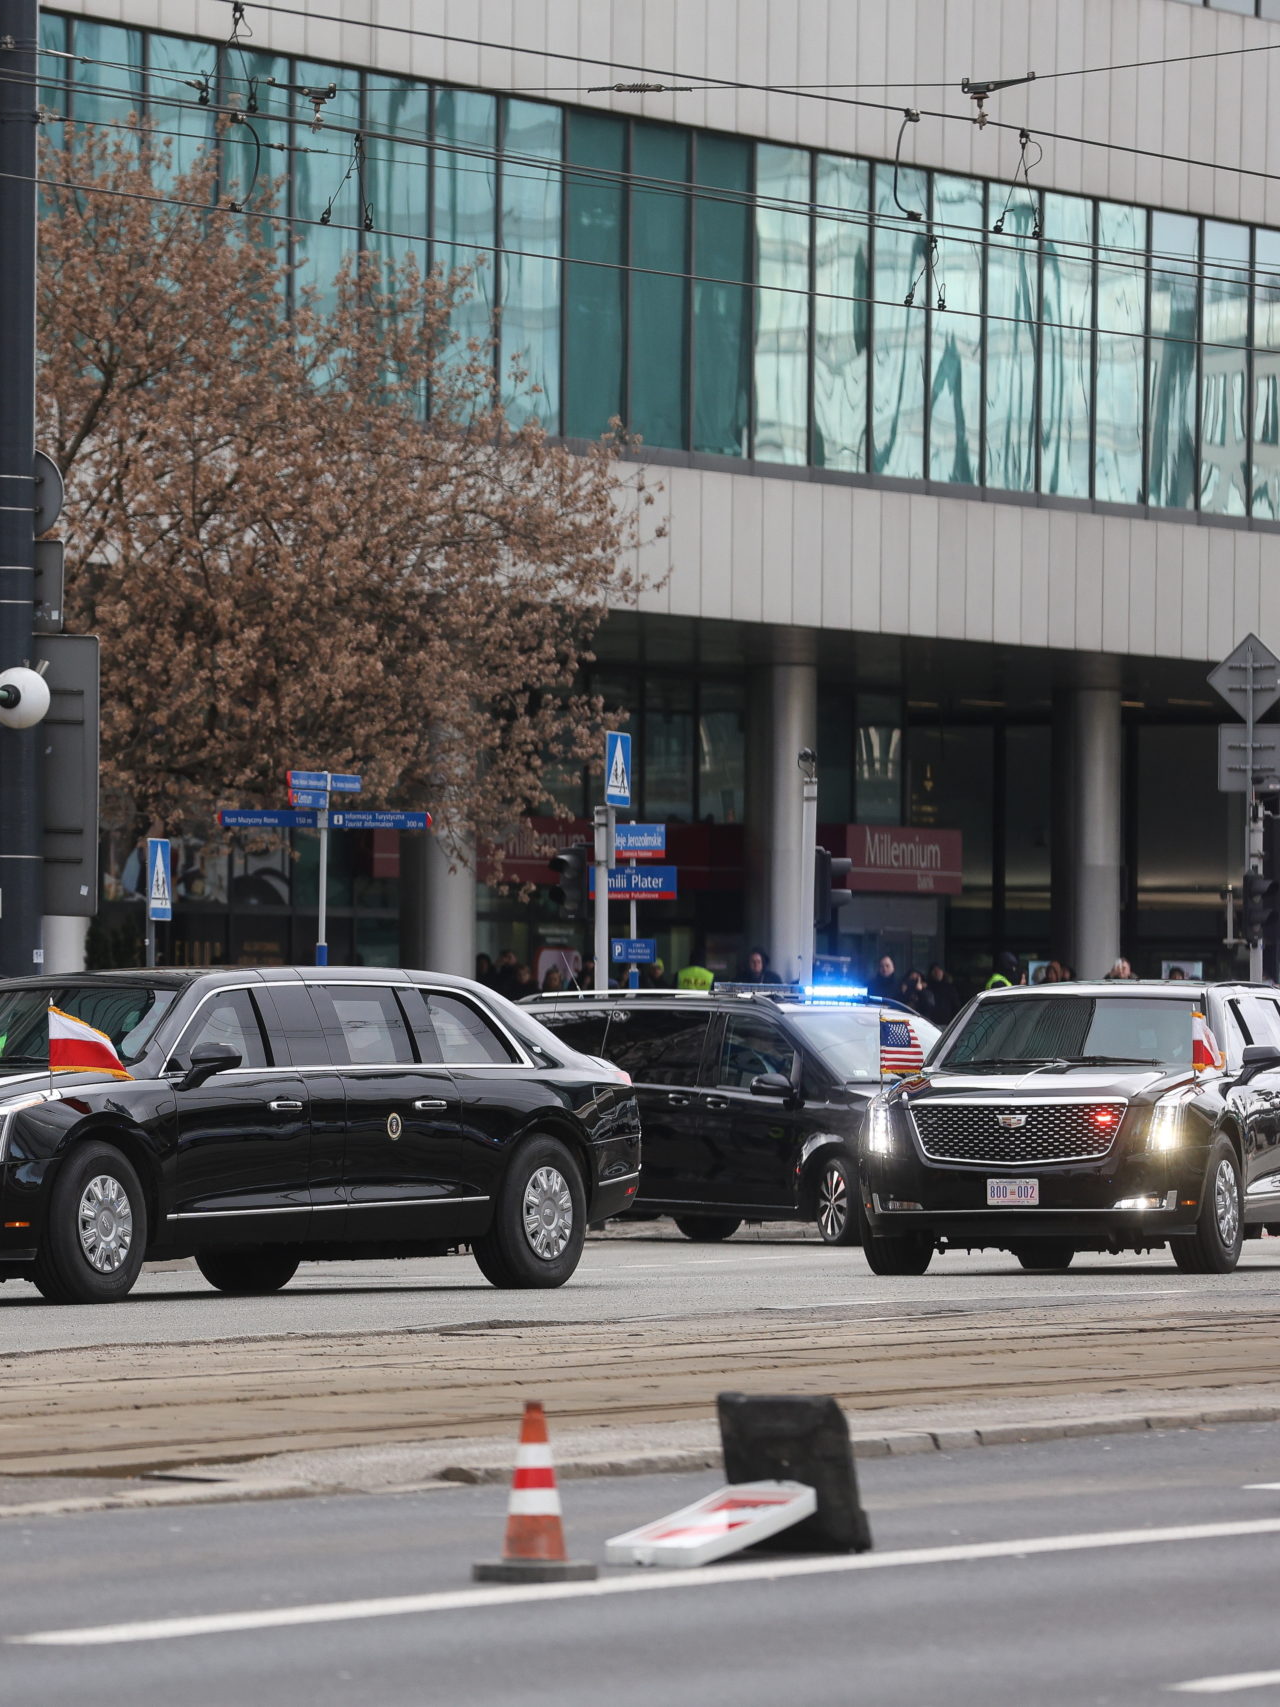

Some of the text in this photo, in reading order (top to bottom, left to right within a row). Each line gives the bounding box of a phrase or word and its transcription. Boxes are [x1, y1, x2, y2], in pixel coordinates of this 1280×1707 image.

[224, 816, 237, 824] Teatr
[237, 816, 263, 825] Muzyczny
[295, 817, 307, 825] 150
[344, 813, 405, 822] Informacja Turystyczna
[363, 820, 394, 828] Information
[406, 820, 418, 828] 300
[614, 833, 662, 849] leje Jerozolimskie
[865, 825, 941, 869] Millennium
[608, 874, 664, 889] milii Plater
[615, 944, 622, 957] P
[990, 1185, 1035, 1199] 800 002
